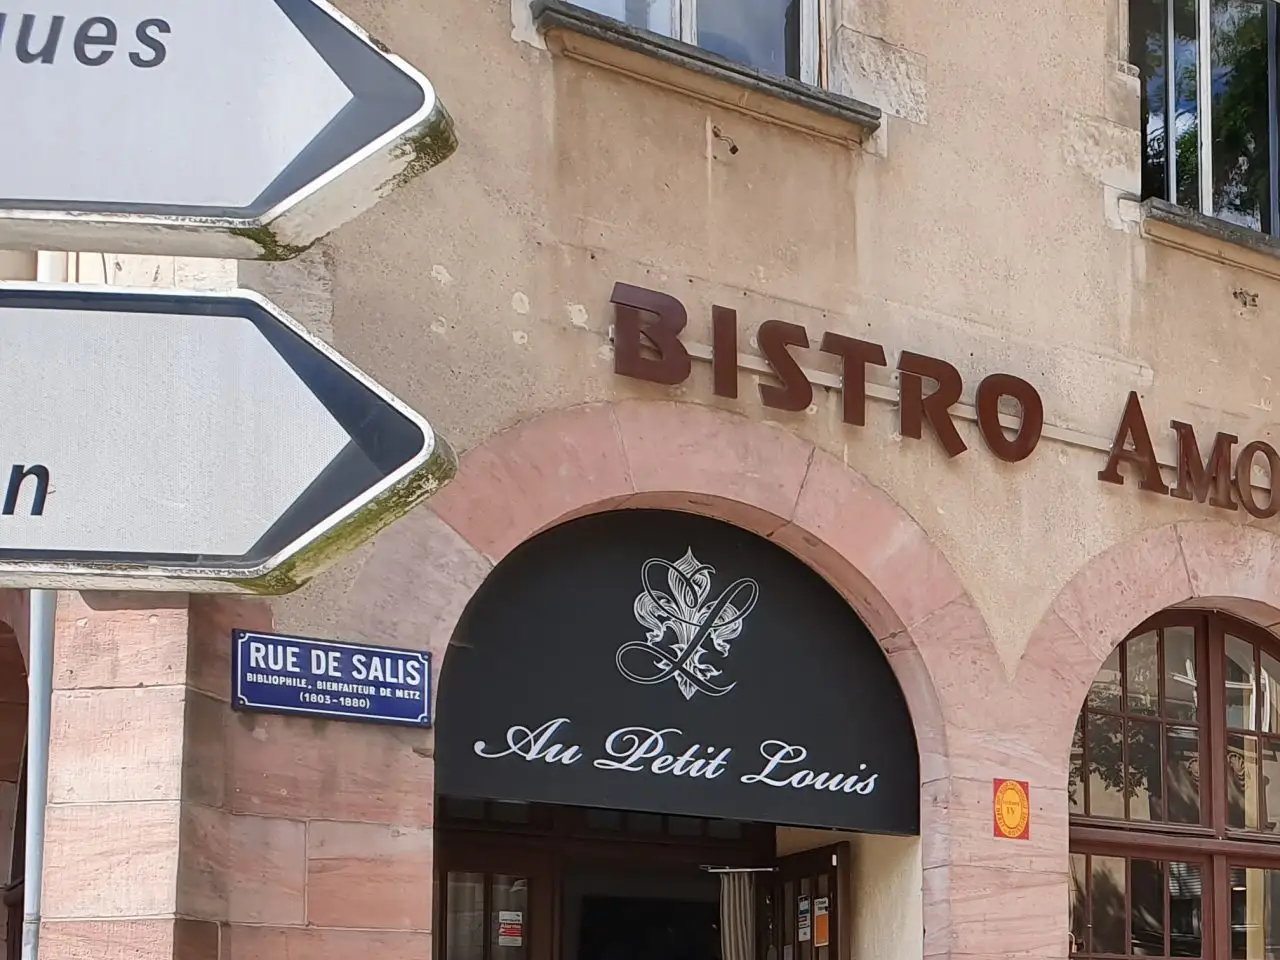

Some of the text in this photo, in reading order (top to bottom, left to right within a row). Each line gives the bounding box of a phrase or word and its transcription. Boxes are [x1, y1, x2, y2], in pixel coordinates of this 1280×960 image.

[0, 12, 171, 68] ues
[611, 281, 1044, 464] BISTRO
[249, 641, 422, 685] RUE DE SALIS
[299, 691, 371, 710] (1803-1880)
[316, 680, 376, 696] BIENFAITEUR
[379, 687, 392, 698] DE
[395, 689, 421, 700] METZ
[473, 717, 880, 796] Au Petit Louis
